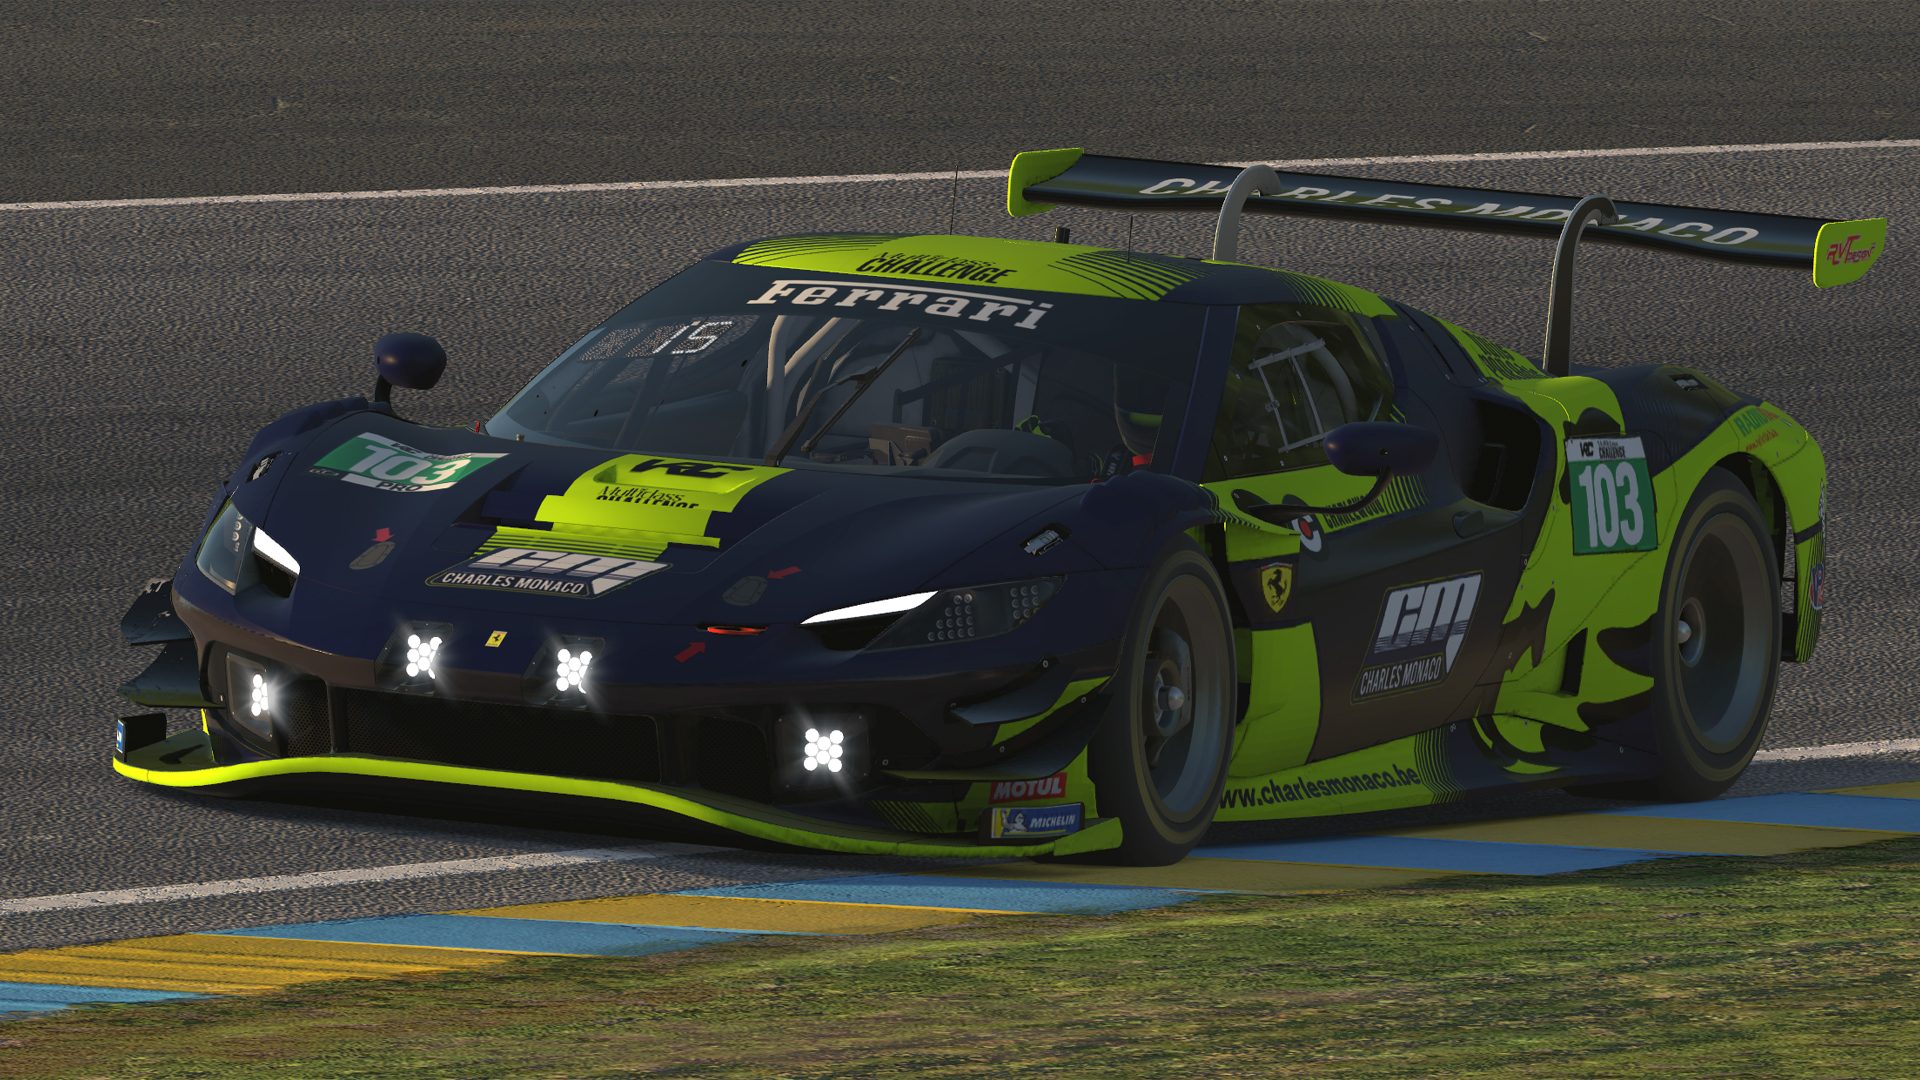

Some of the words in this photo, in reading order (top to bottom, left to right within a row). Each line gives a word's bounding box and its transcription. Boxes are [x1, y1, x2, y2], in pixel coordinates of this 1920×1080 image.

[1138, 177, 1456, 210] CHRLES
[1457, 202, 1760, 246] MOACO
[855, 256, 1018, 284] CHALLENGE
[746, 280, 1053, 330] Ferrari
[348, 444, 473, 485] 103
[373, 482, 424, 492] PRO
[599, 486, 685, 502] Multiclass
[1578, 461, 1644, 548] 103
[441, 572, 516, 589] CHARLES
[513, 576, 585, 595] MONACO
[1360, 664, 1402, 696] CHARLES
[1401, 655, 1442, 686] MONACO
[993, 776, 1062, 801] MOTUL
[1219, 764, 1421, 810] ww.charlesmonaco.be
[1029, 814, 1076, 829] MICHELIN
